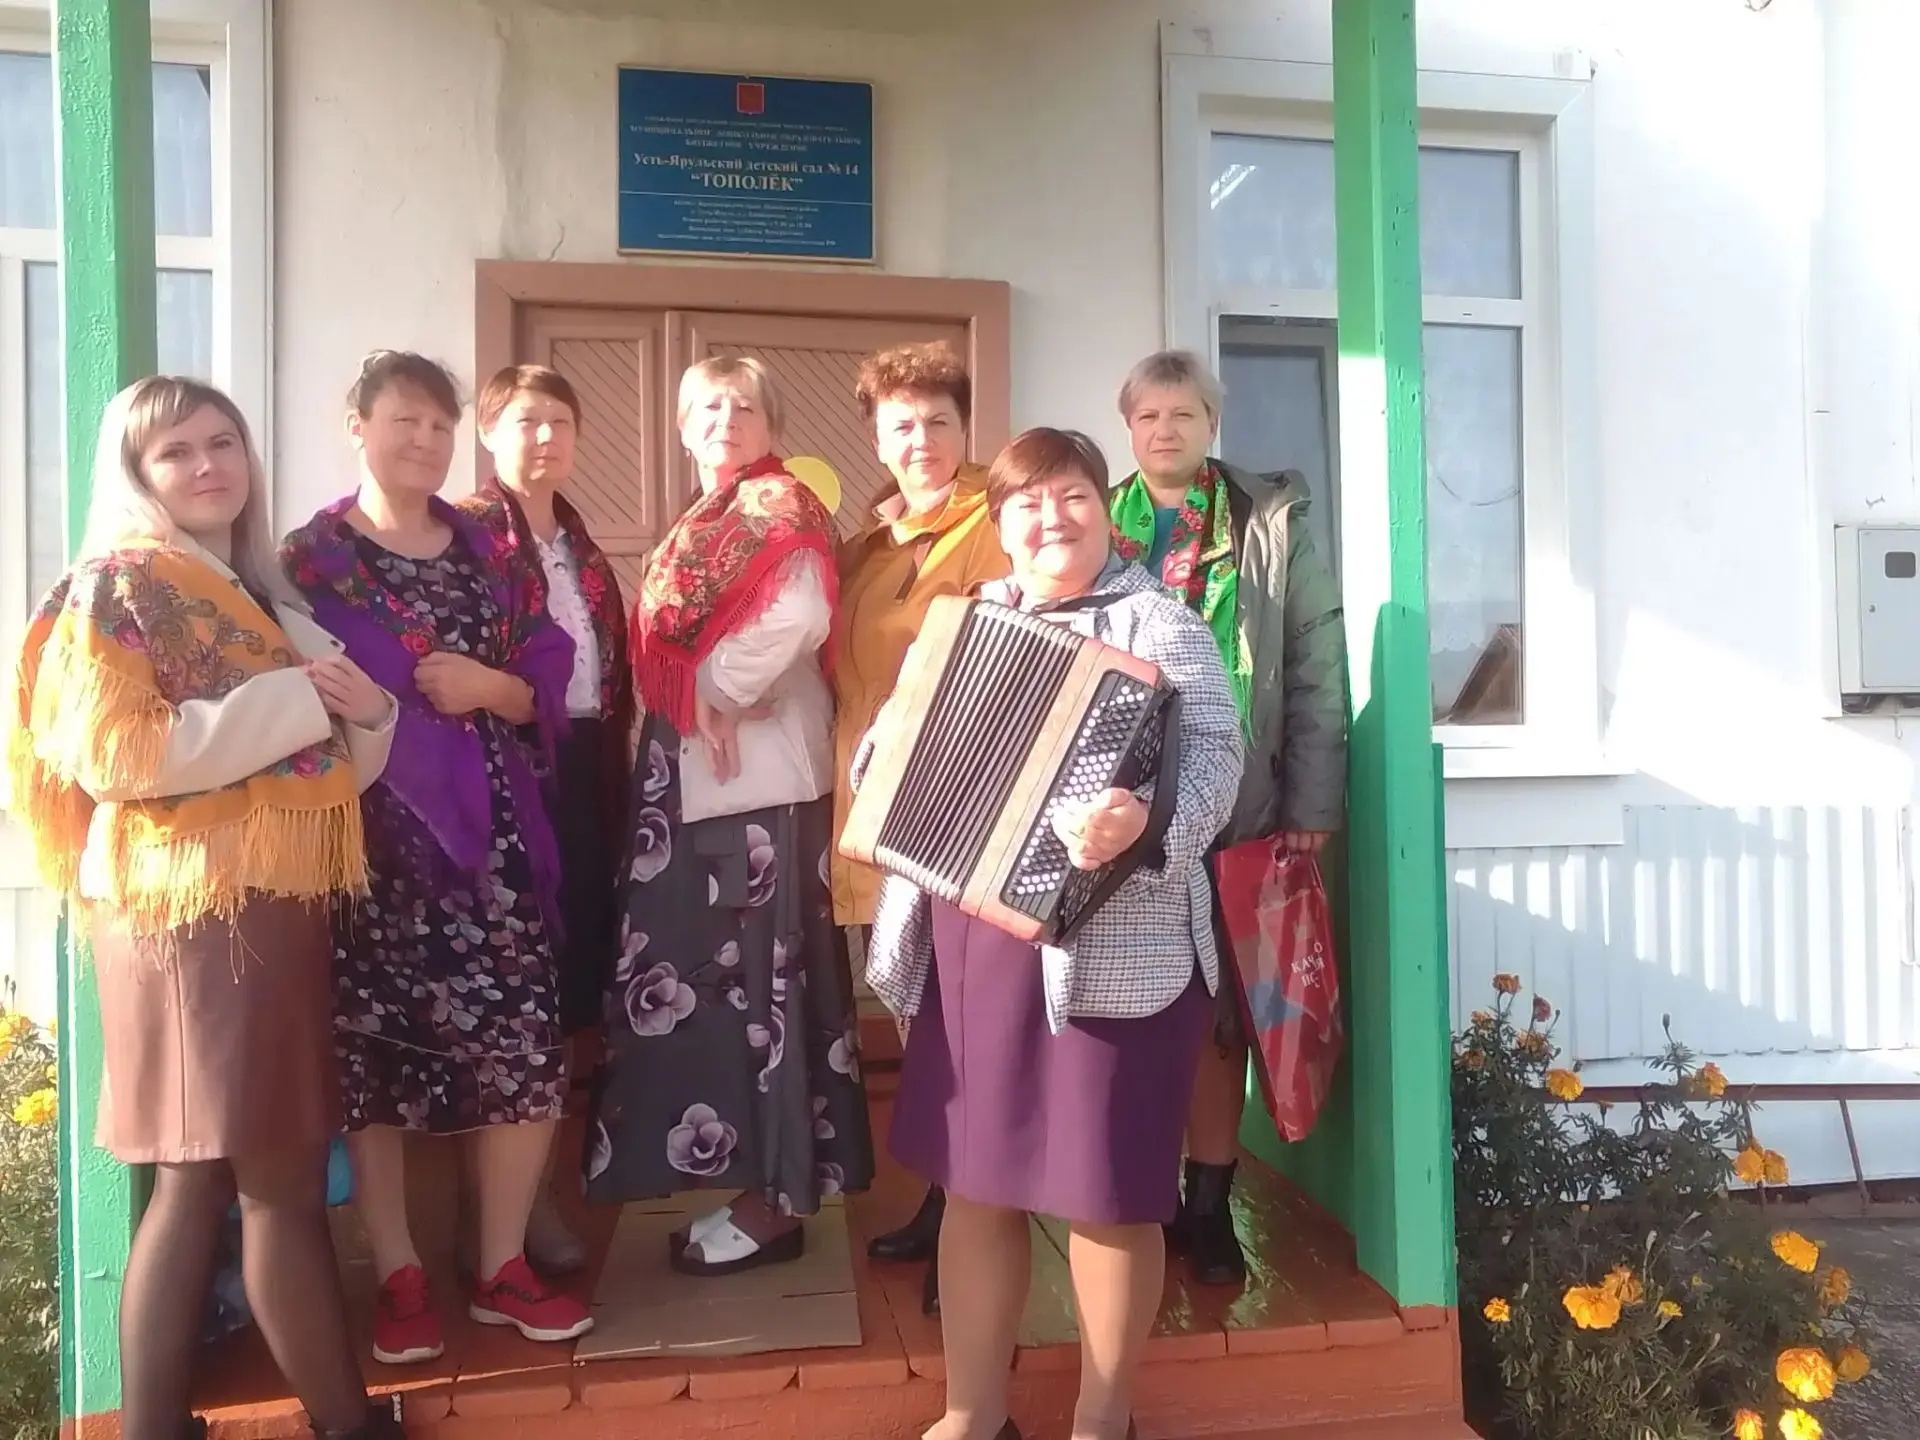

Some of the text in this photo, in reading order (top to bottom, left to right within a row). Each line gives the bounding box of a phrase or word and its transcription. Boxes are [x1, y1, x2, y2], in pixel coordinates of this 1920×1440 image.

[633, 152, 859, 176] Усть-Ярульский детский сад № 14
